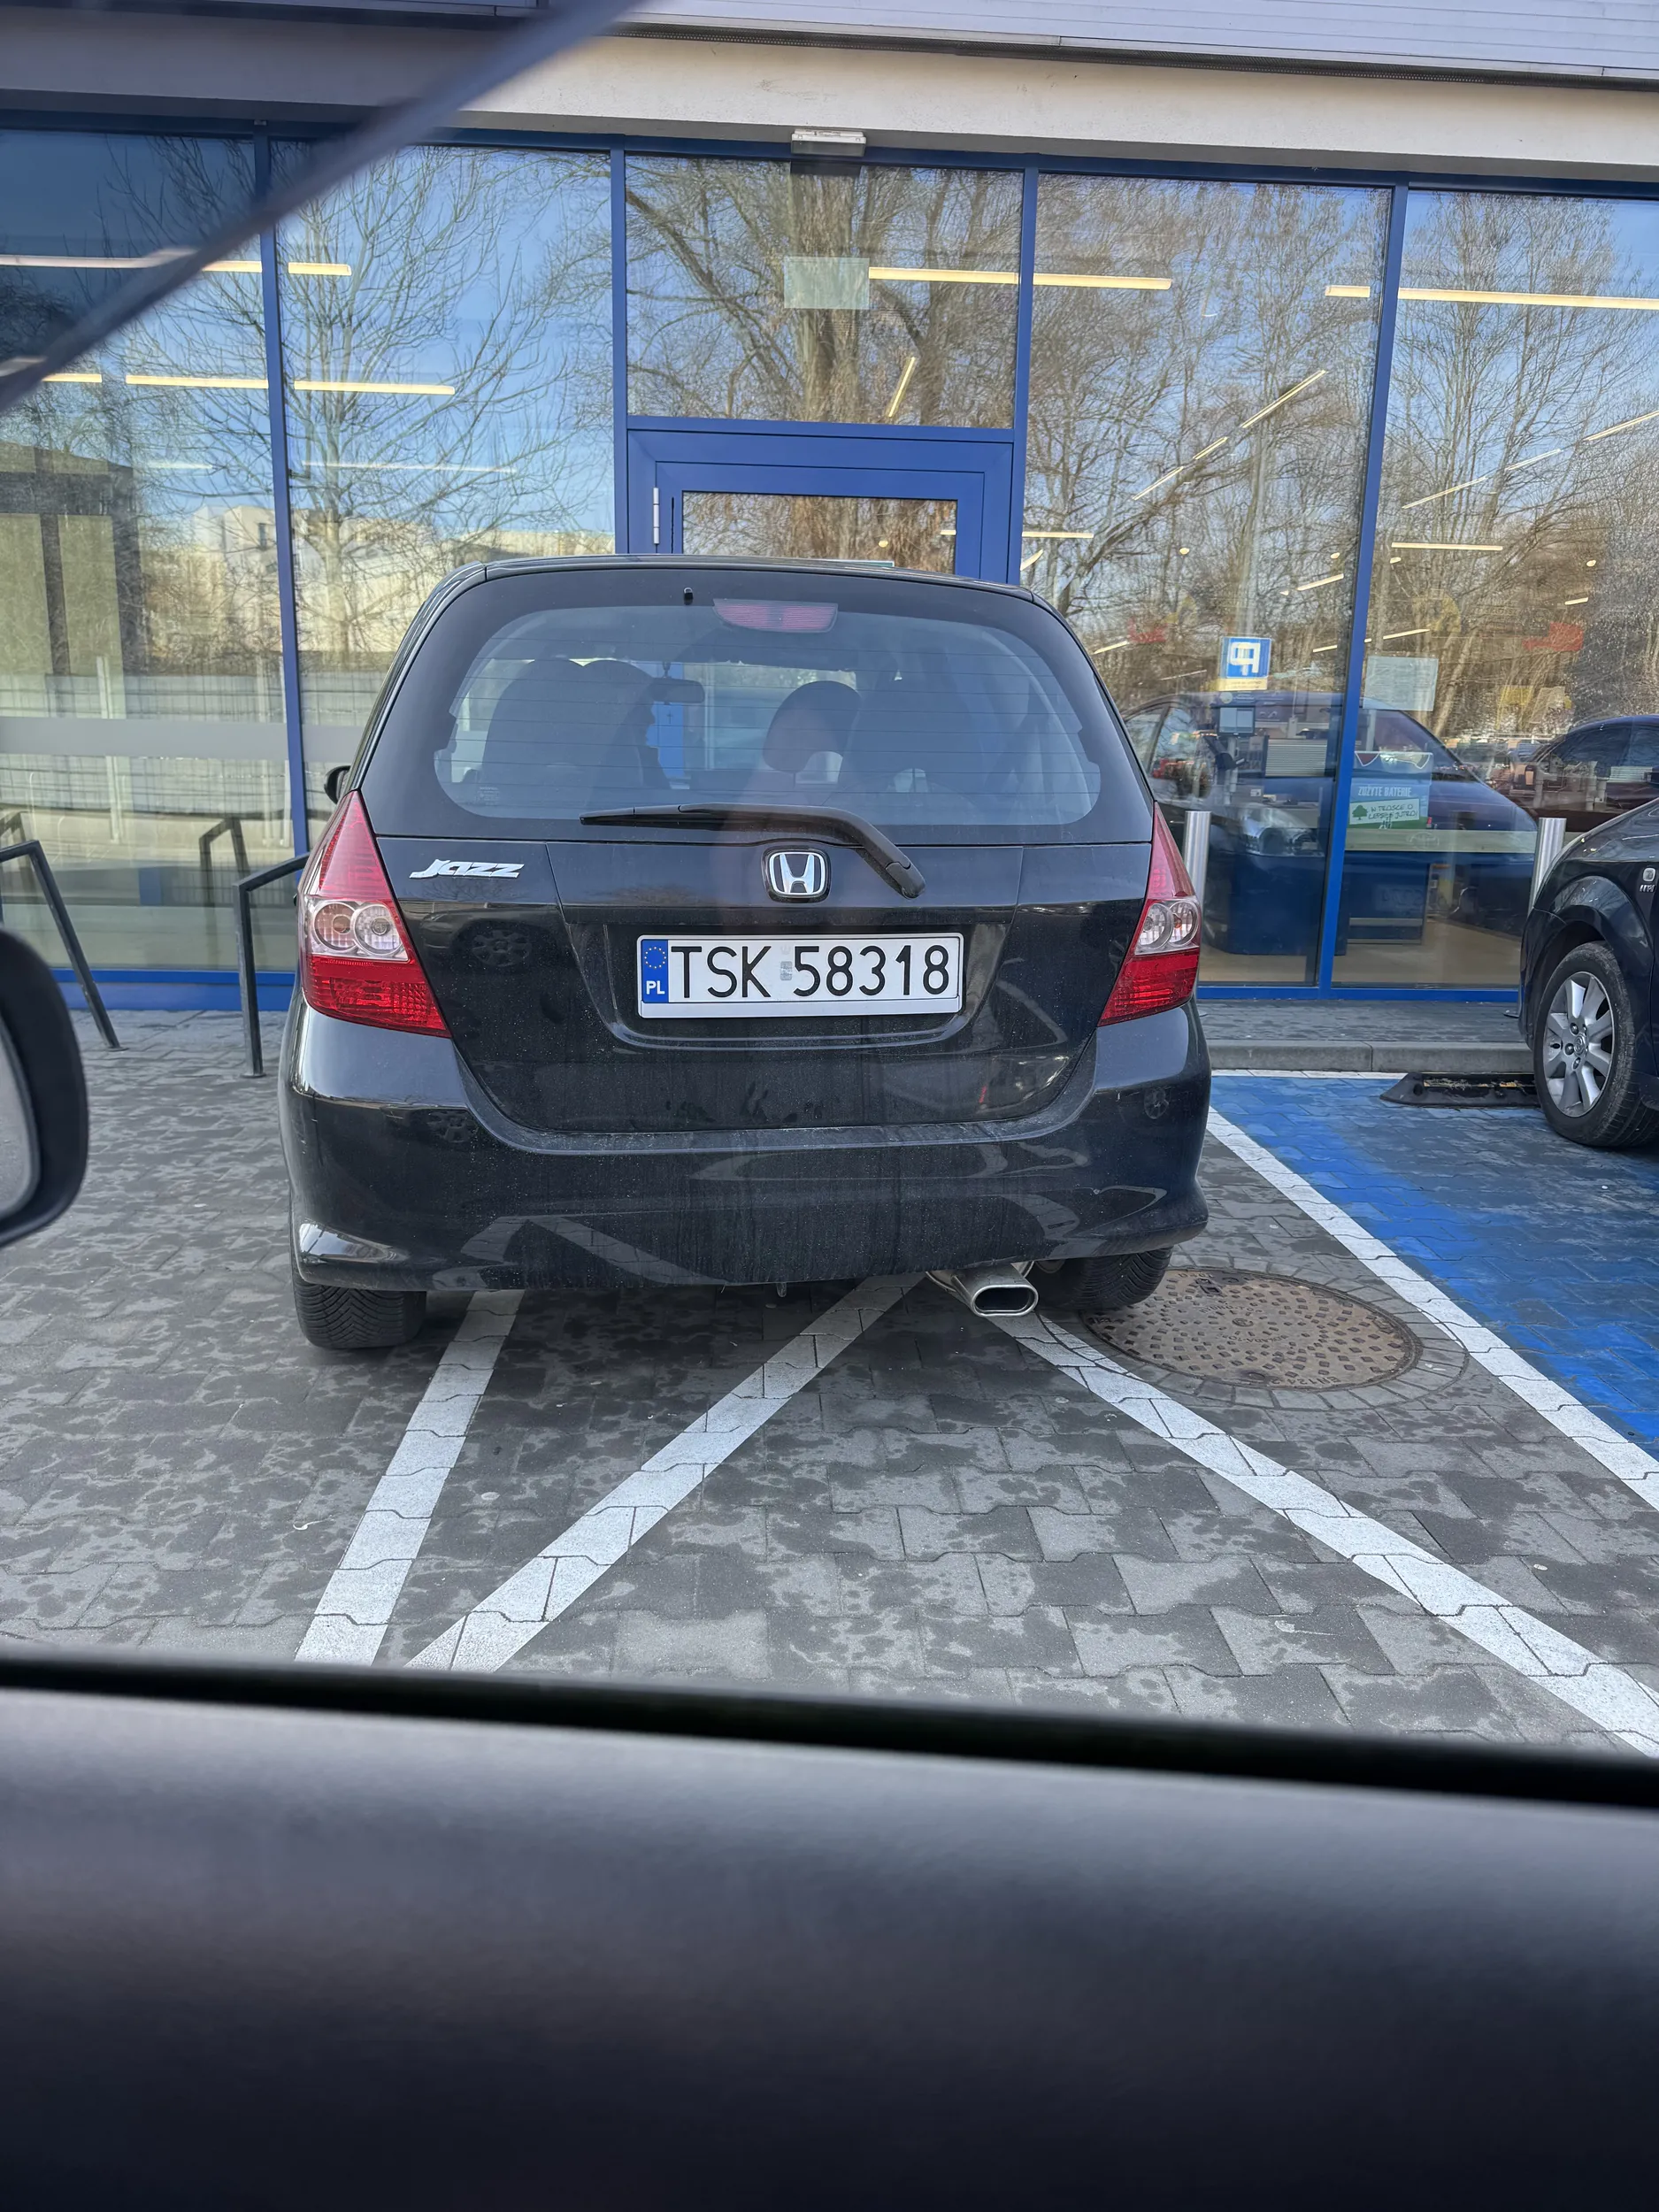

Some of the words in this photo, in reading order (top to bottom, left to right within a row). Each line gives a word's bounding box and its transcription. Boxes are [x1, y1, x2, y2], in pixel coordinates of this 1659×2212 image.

[1384, 787, 1412, 797] BATERIE
[671, 945, 772, 999] TSK
[793, 944, 950, 997] 58318
[646, 980, 664, 995] PL
